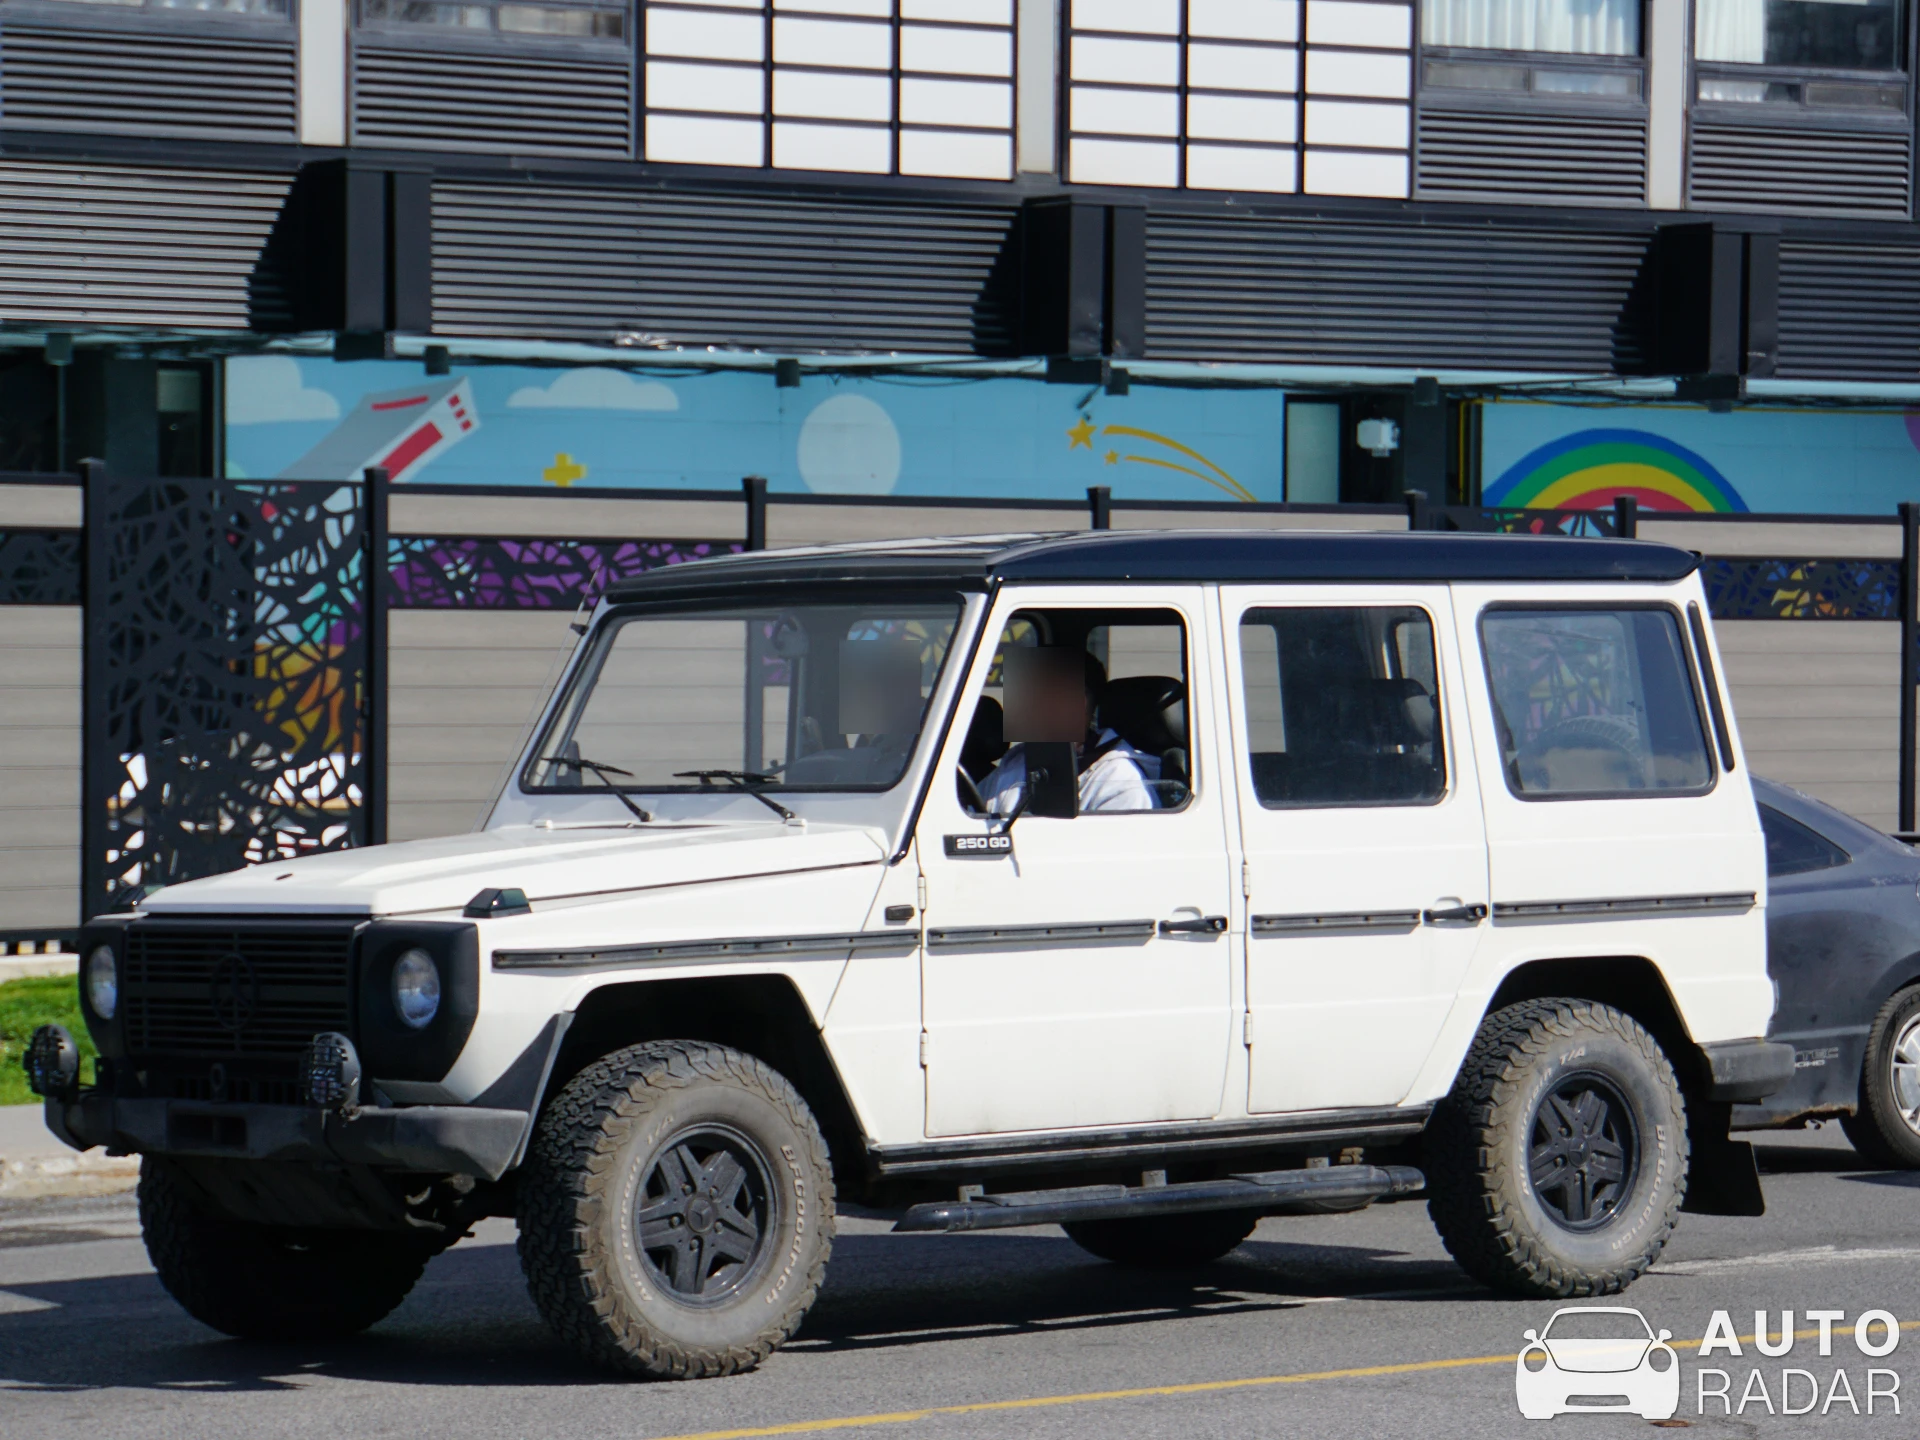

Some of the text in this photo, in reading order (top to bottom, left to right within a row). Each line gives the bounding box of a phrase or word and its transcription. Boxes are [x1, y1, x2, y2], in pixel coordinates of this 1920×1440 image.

[956, 836, 1010, 849] 250 GD
[1559, 1046, 1586, 1066] T/A
